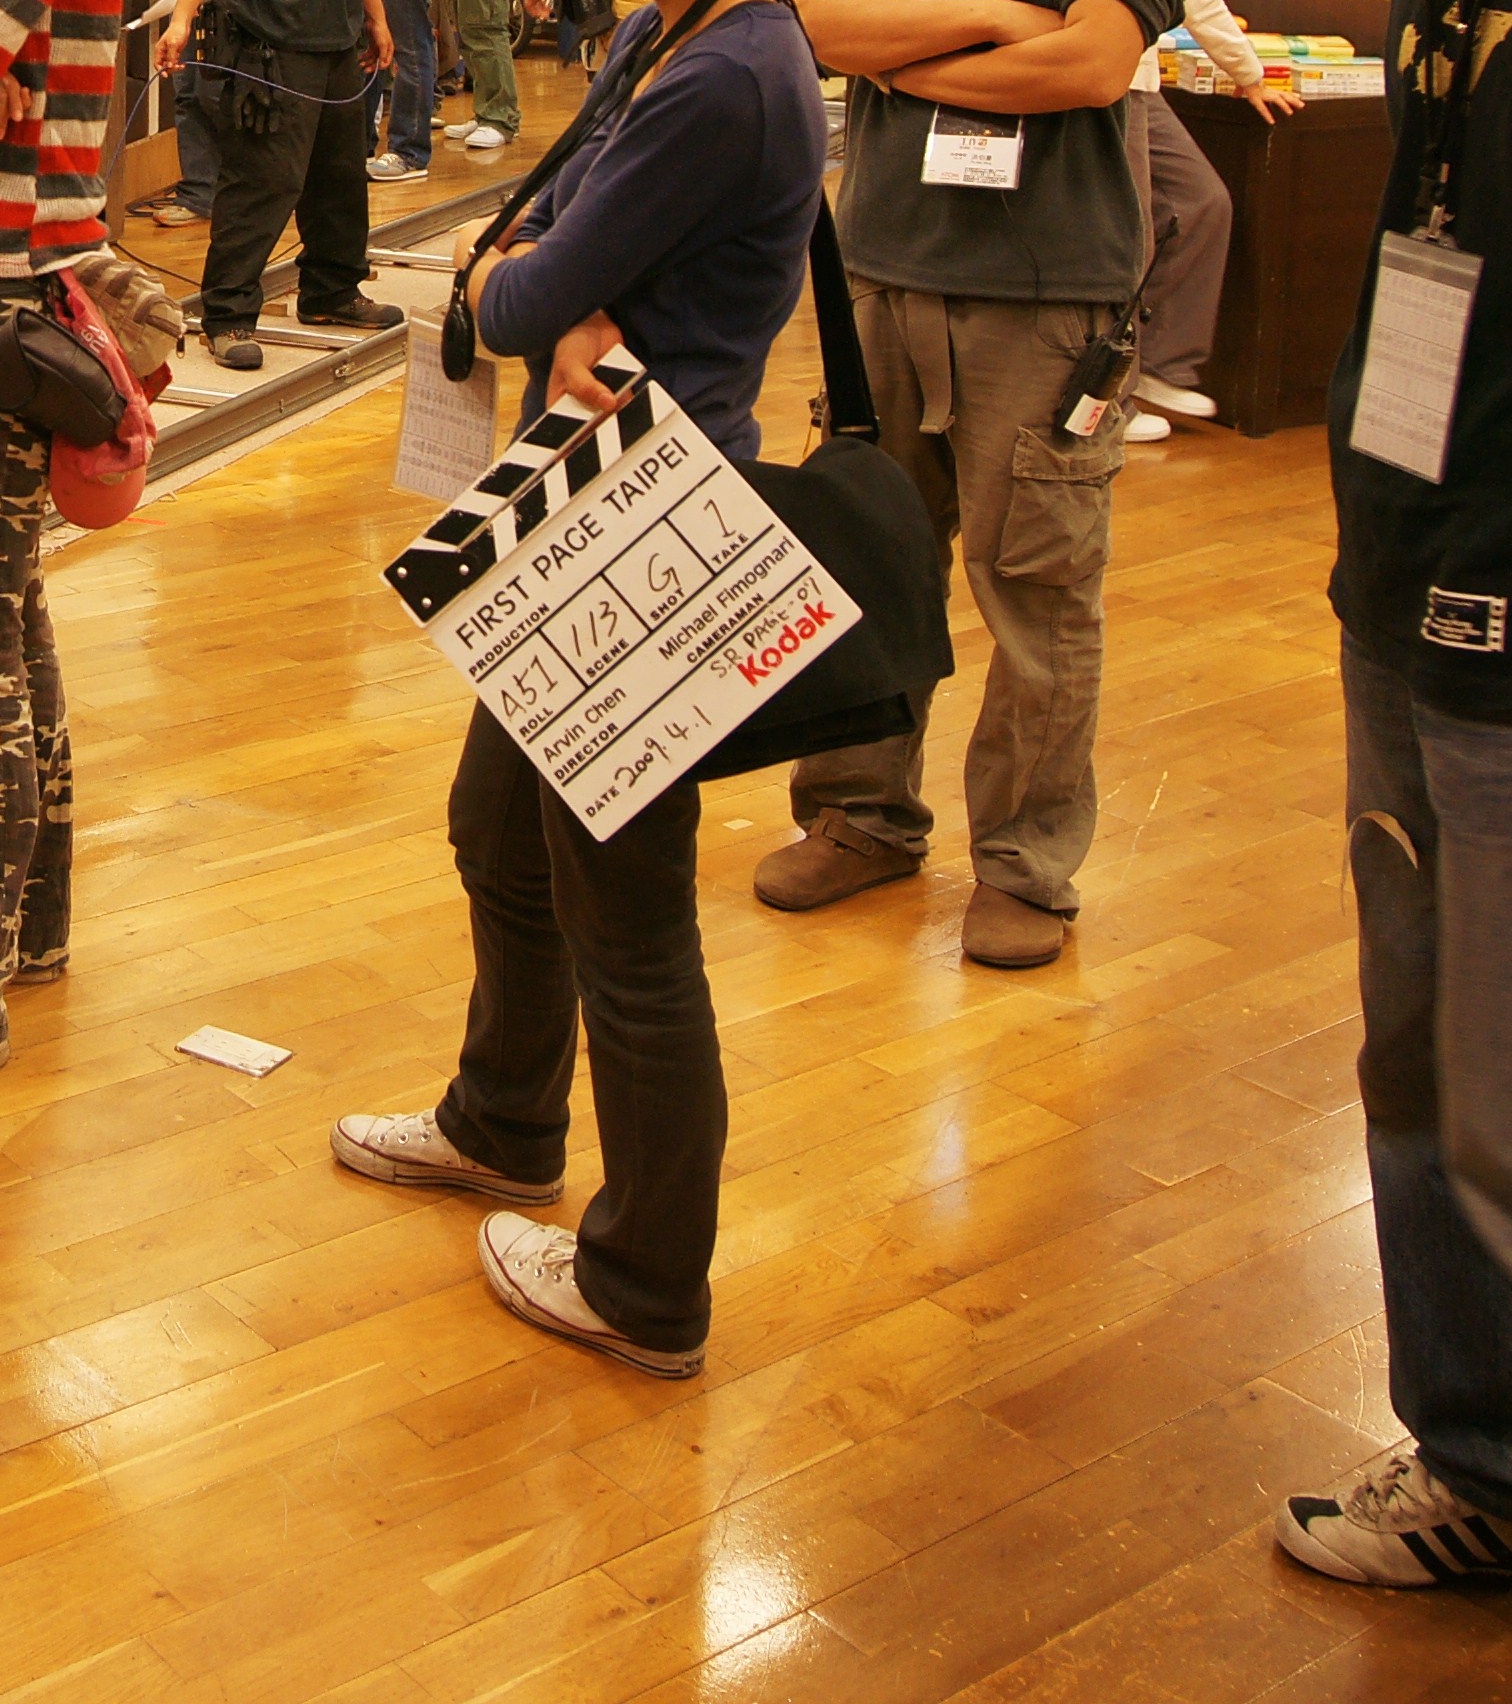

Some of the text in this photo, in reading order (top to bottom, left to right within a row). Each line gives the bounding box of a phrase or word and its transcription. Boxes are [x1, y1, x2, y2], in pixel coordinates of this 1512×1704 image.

[455, 436, 691, 650] FIRST PAGE TAIPEI
[711, 533, 750, 565] TAKE
[647, 553, 681, 594] G
[658, 535, 796, 661] Michael Fimognari
[571, 600, 618, 658] 113
[650, 587, 686, 621] SHOT
[686, 592, 764, 665] CAMERAMAN
[468, 602, 551, 678] PRODUCTION
[586, 637, 630, 678] SCENE
[736, 600, 836, 688] Kodak
[519, 706, 554, 738] ROLL
[542, 687, 627, 764] Arvin Chen
[553, 722, 619, 781] DIRECTOR
[585, 786, 620, 819] DATE
